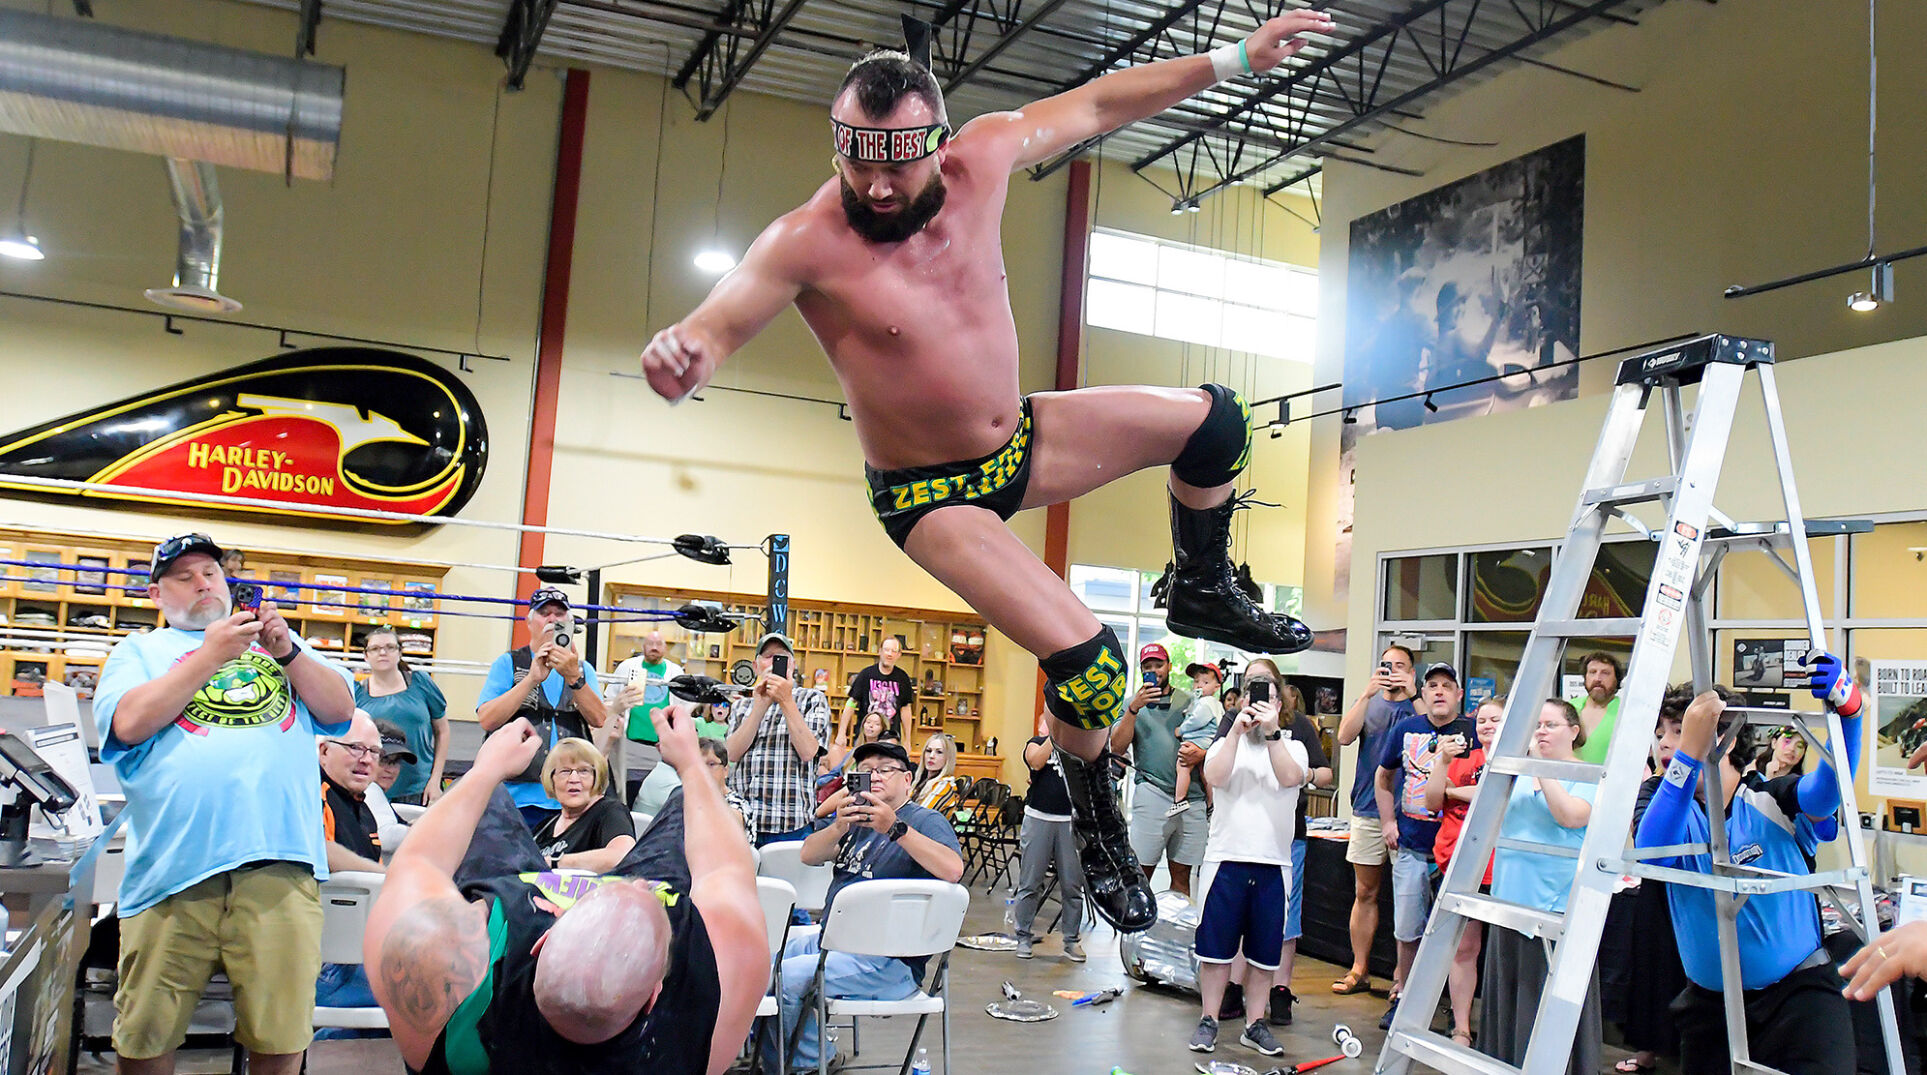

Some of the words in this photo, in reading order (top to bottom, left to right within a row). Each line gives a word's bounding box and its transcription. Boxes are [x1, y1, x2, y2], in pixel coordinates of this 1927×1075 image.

[838, 125, 853, 156] OF
[856, 130, 887, 160] THE
[892, 128, 927, 160] BEST
[188, 442, 294, 469] HARLEY-
[221, 466, 334, 496] DAVIDSON
[890, 473, 970, 510] ZEST
[1057, 646, 1122, 703] ZEST
[1878, 668, 1898, 680] BORN
[1901, 668, 1910, 681] TO
[1901, 682, 1910, 694] TO
